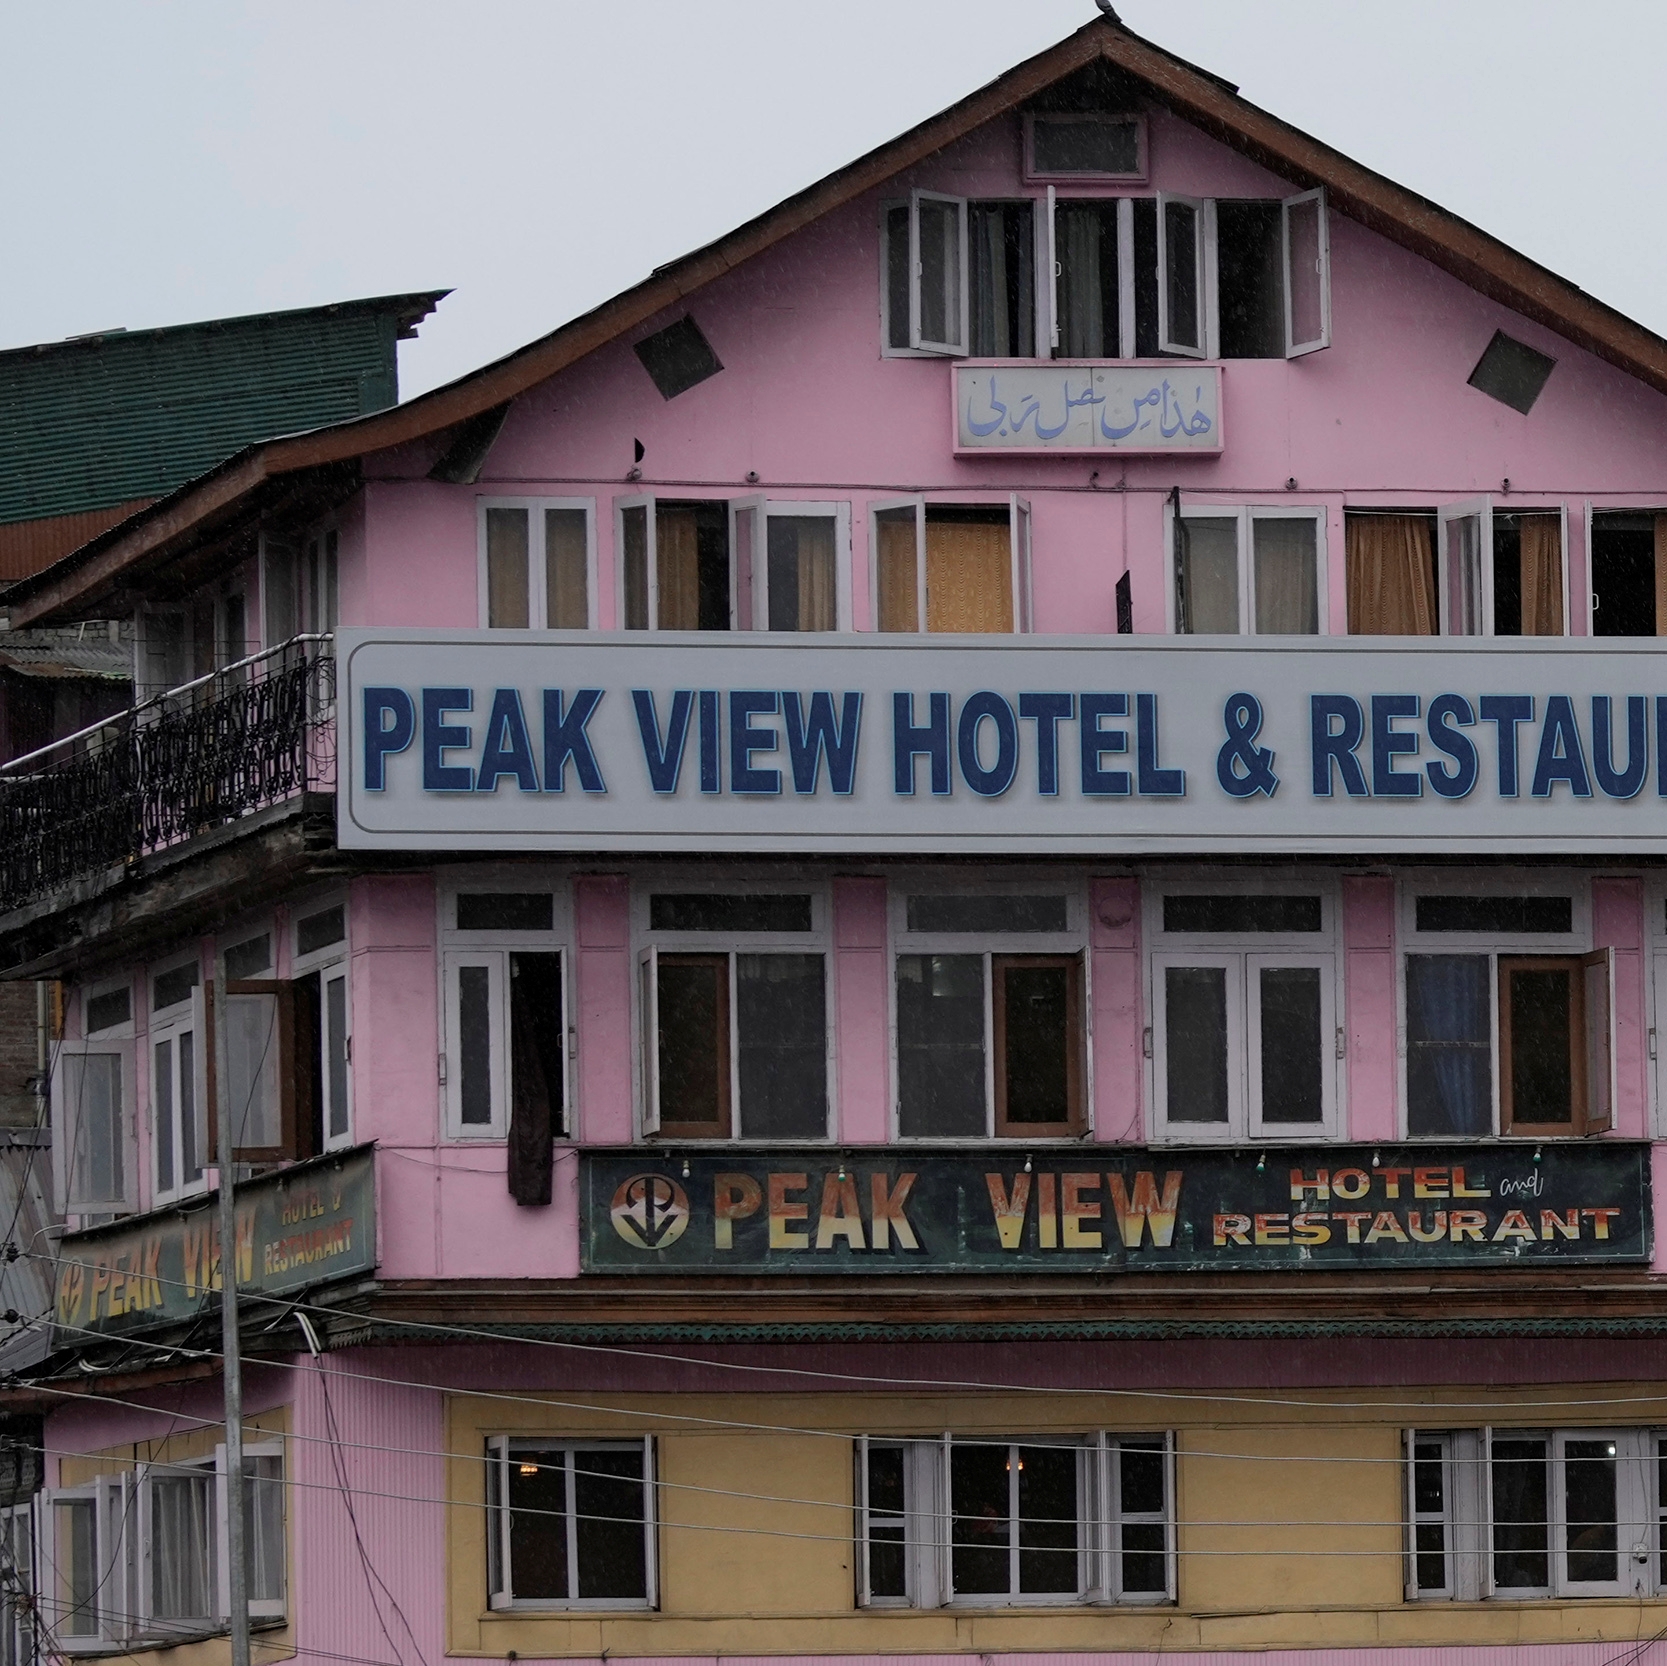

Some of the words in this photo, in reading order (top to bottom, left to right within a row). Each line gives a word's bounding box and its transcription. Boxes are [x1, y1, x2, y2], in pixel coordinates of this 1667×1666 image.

[363, 686, 607, 793] PEAK
[631, 690, 863, 795] VIEW
[893, 690, 1186, 797] HOTEL
[1217, 692, 1279, 798] &
[282, 1187, 325, 1226] HOTEL
[714, 1172, 922, 1250] PEAK
[984, 1170, 1184, 1249] VIEW
[1290, 1167, 1492, 1200] HOTEL
[1499, 1168, 1544, 1197] and
[264, 1217, 354, 1276] RESTAURANT
[1213, 1207, 1621, 1246] RESTAURANT
[89, 1234, 164, 1322] PEAK
